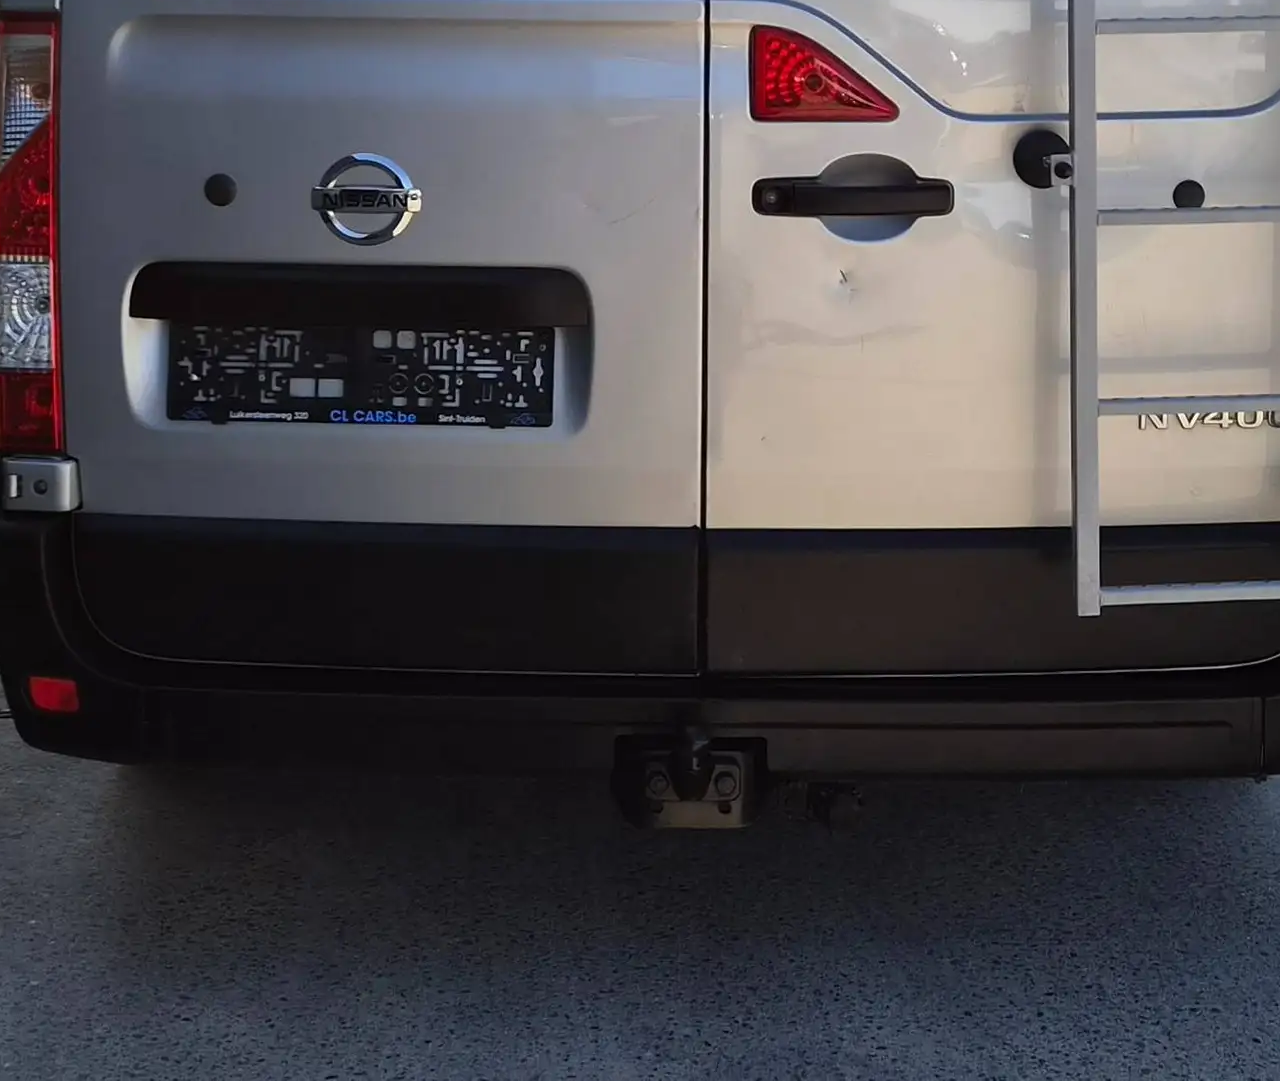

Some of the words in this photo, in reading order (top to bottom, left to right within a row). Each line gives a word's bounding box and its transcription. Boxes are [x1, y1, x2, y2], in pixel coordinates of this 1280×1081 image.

[322, 193, 408, 208] NISSAN
[330, 409, 349, 422] CL
[352, 409, 417, 423] CARS.be
